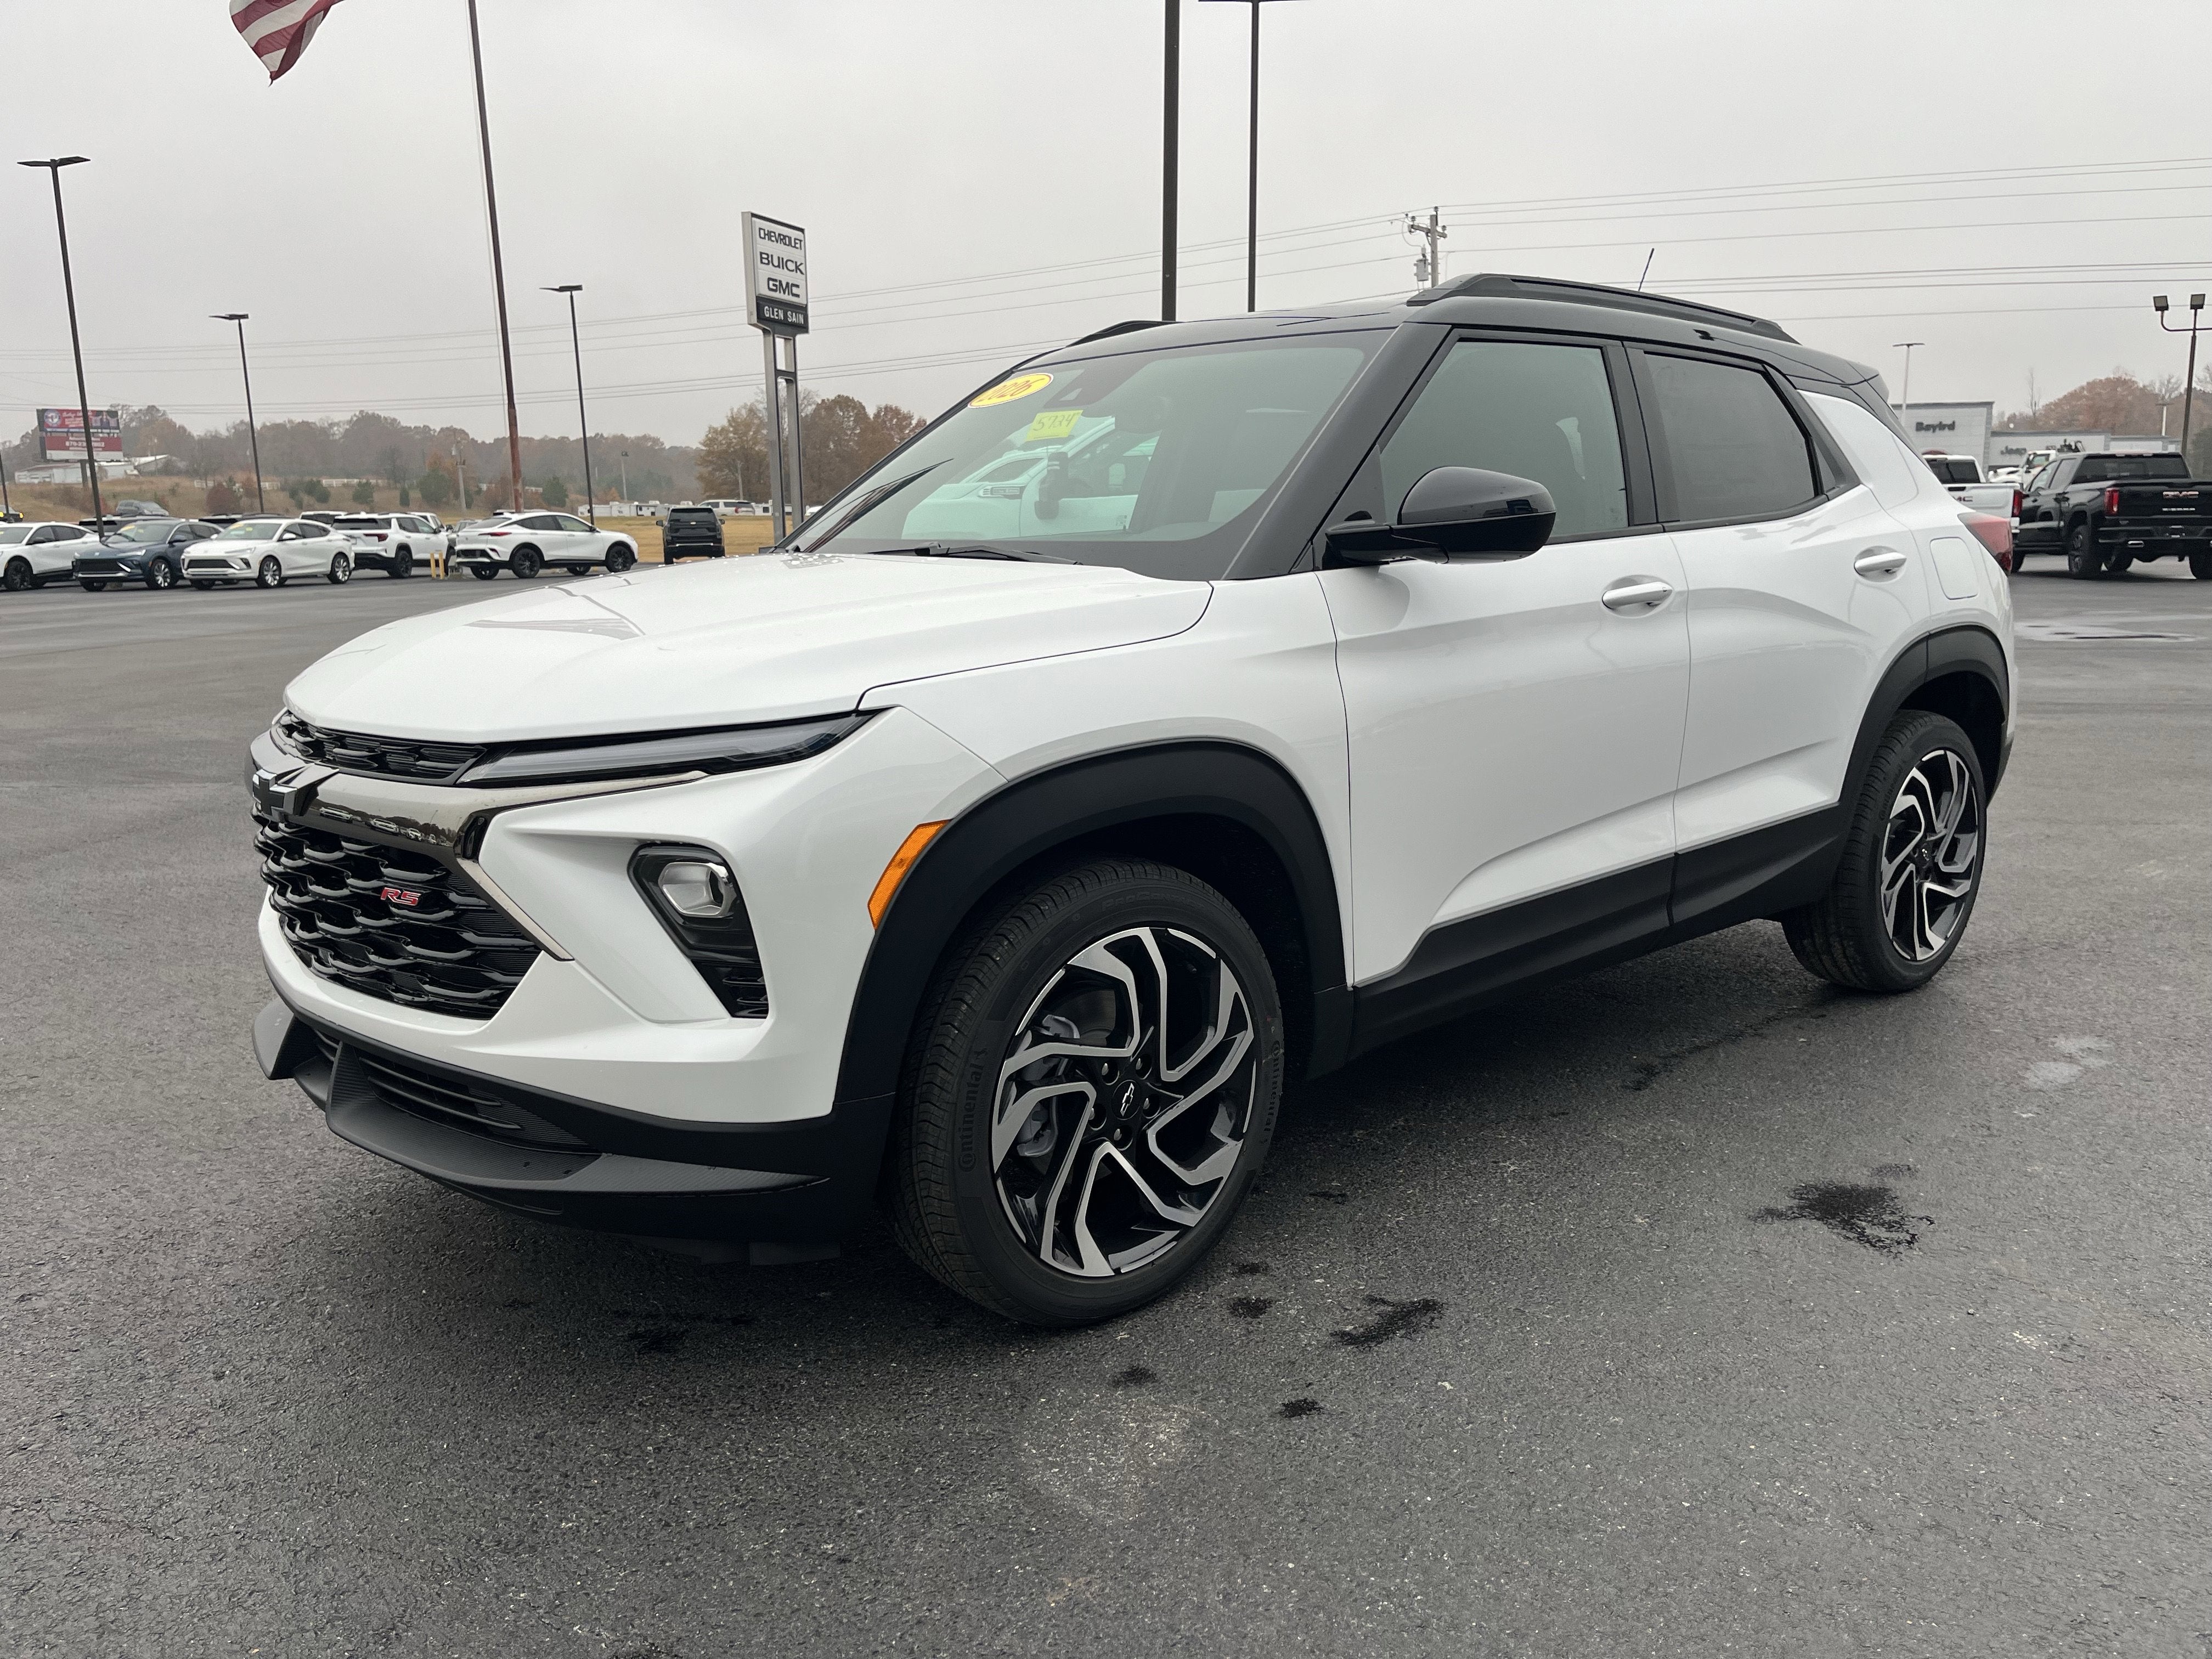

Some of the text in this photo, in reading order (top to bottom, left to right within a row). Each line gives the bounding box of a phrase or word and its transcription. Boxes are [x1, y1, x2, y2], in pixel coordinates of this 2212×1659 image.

[758, 227, 803, 250] CHEVROLET
[759, 251, 804, 275] BUICK
[768, 277, 800, 298] GMC
[764, 306, 804, 325] GLEN SAIN
[974, 378, 1045, 403] 2026
[381, 887, 421, 906] RS
